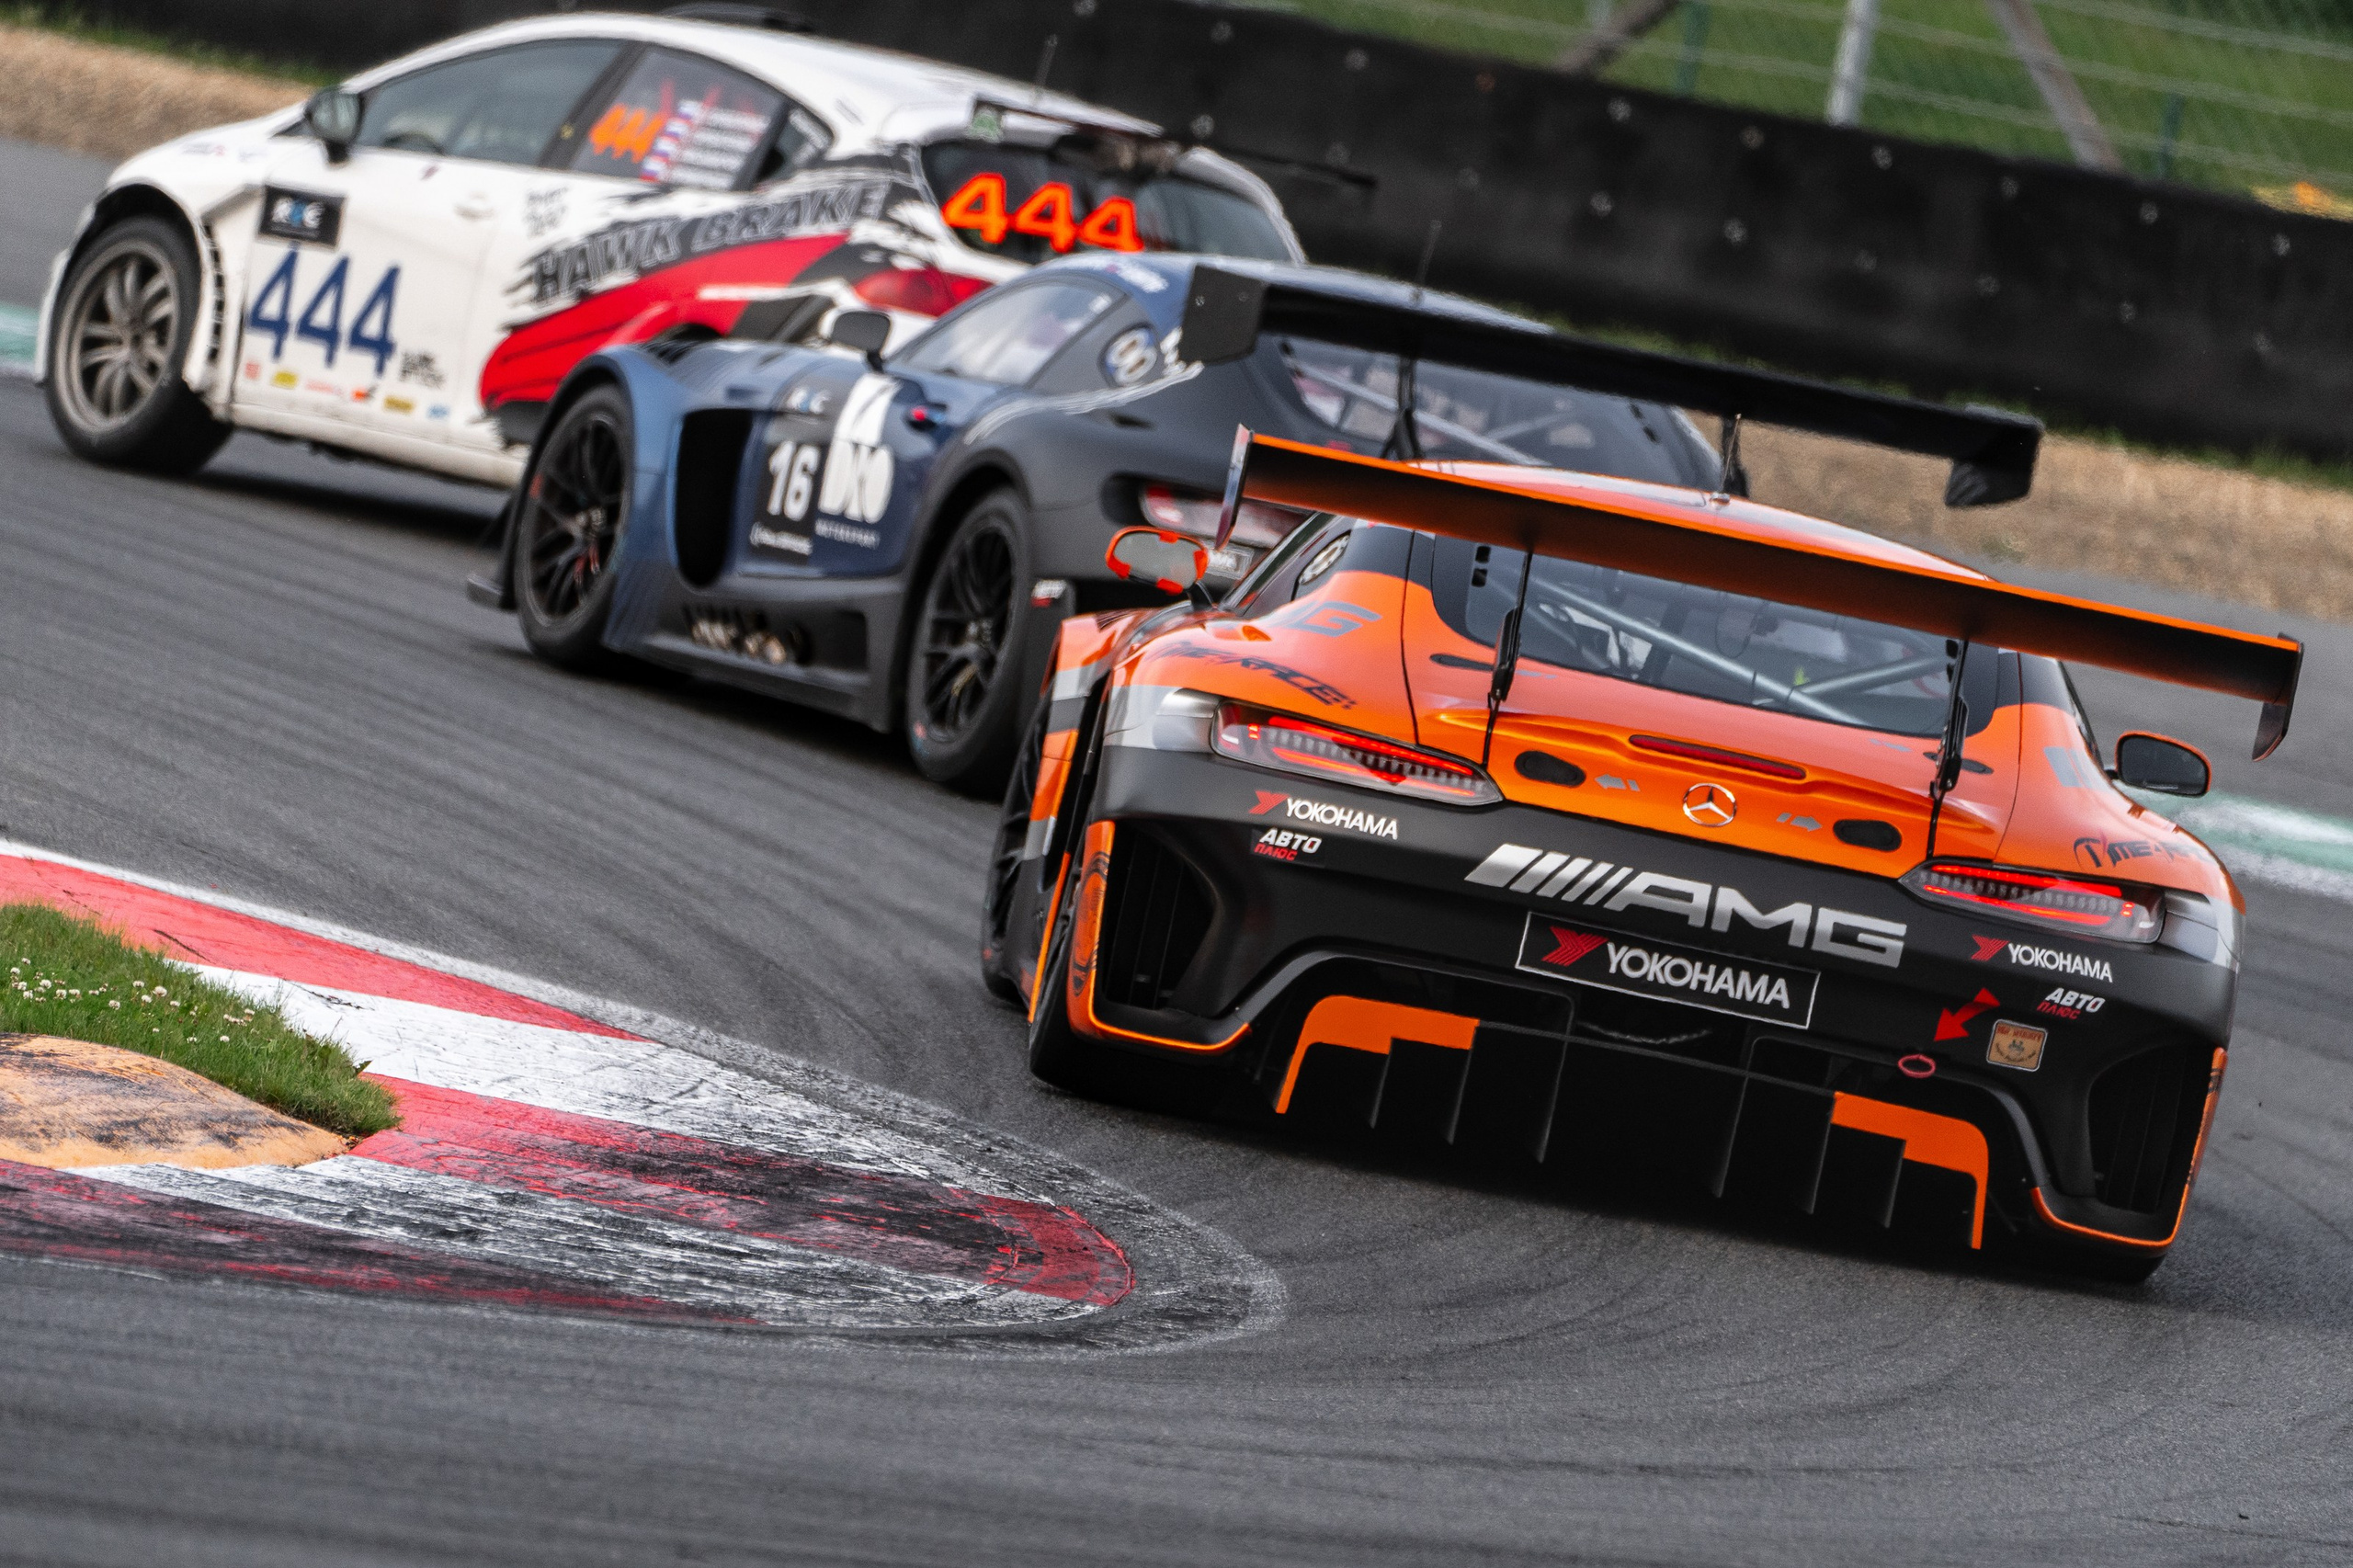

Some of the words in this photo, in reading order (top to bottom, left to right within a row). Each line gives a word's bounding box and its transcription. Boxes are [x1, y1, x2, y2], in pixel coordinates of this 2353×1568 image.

[589, 102, 665, 164] 444
[940, 172, 1145, 255] 444
[248, 246, 403, 379] 444
[767, 440, 821, 522] 16
[1259, 827, 1323, 854] АВТО
[1286, 797, 1399, 840] YOKOHAMA
[1603, 871, 1908, 969] AMG
[1607, 941, 1791, 1009] YOKOHAMA
[2007, 942, 2114, 983] YOKOHAMA
[2044, 987, 2106, 1012] АВТО
